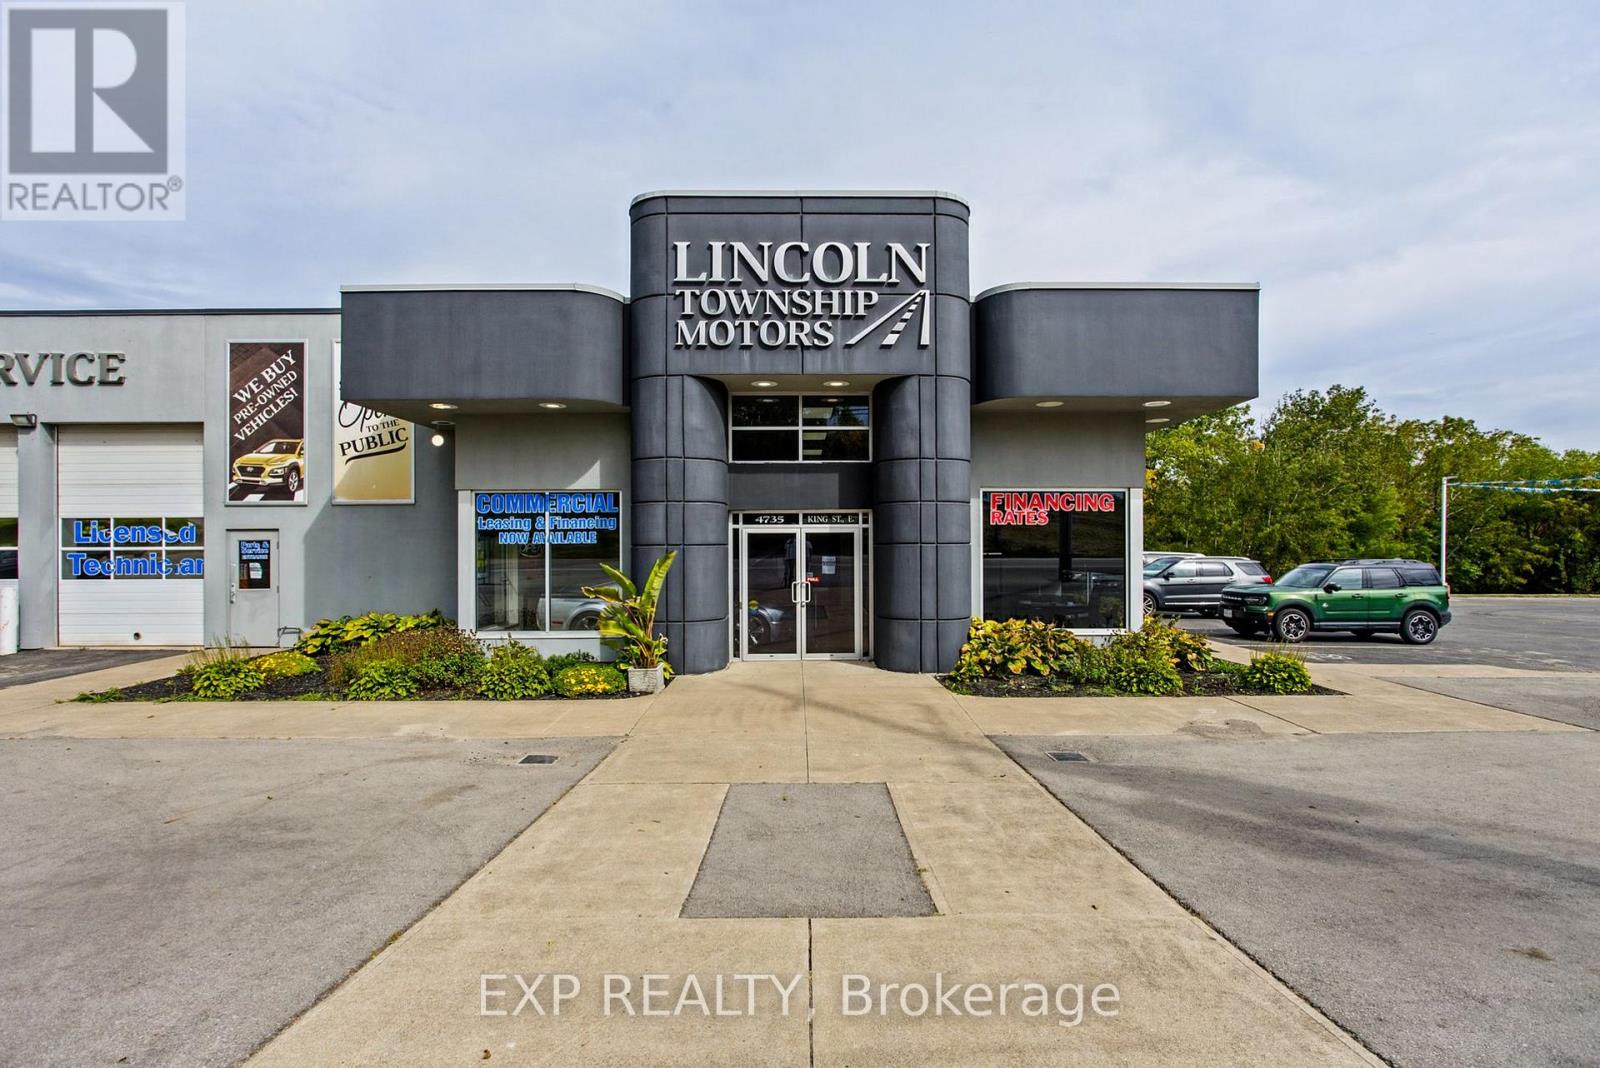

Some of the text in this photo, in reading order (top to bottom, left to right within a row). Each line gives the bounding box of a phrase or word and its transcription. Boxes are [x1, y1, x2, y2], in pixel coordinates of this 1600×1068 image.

[673, 241, 931, 284] LINCOLN
[674, 288, 879, 317] TOWNSHIP
[674, 319, 835, 347] MOTORS
[232, 349, 297, 403] WE BUY
[233, 370, 298, 425] PRE-OWNED
[233, 387, 299, 441] VEHICLES!
[338, 400, 387, 433] Ope
[366, 418, 401, 433] TO THE
[338, 427, 409, 457] PUBLIC
[476, 493, 618, 514] COMMERCIAL
[990, 492, 1116, 512] FINANCING
[477, 516, 617, 531] Leasing & Financing
[754, 515, 785, 524] 4735
[807, 515, 829, 524] KING
[989, 510, 1050, 526] RATES
[498, 531, 530, 544] NOW
